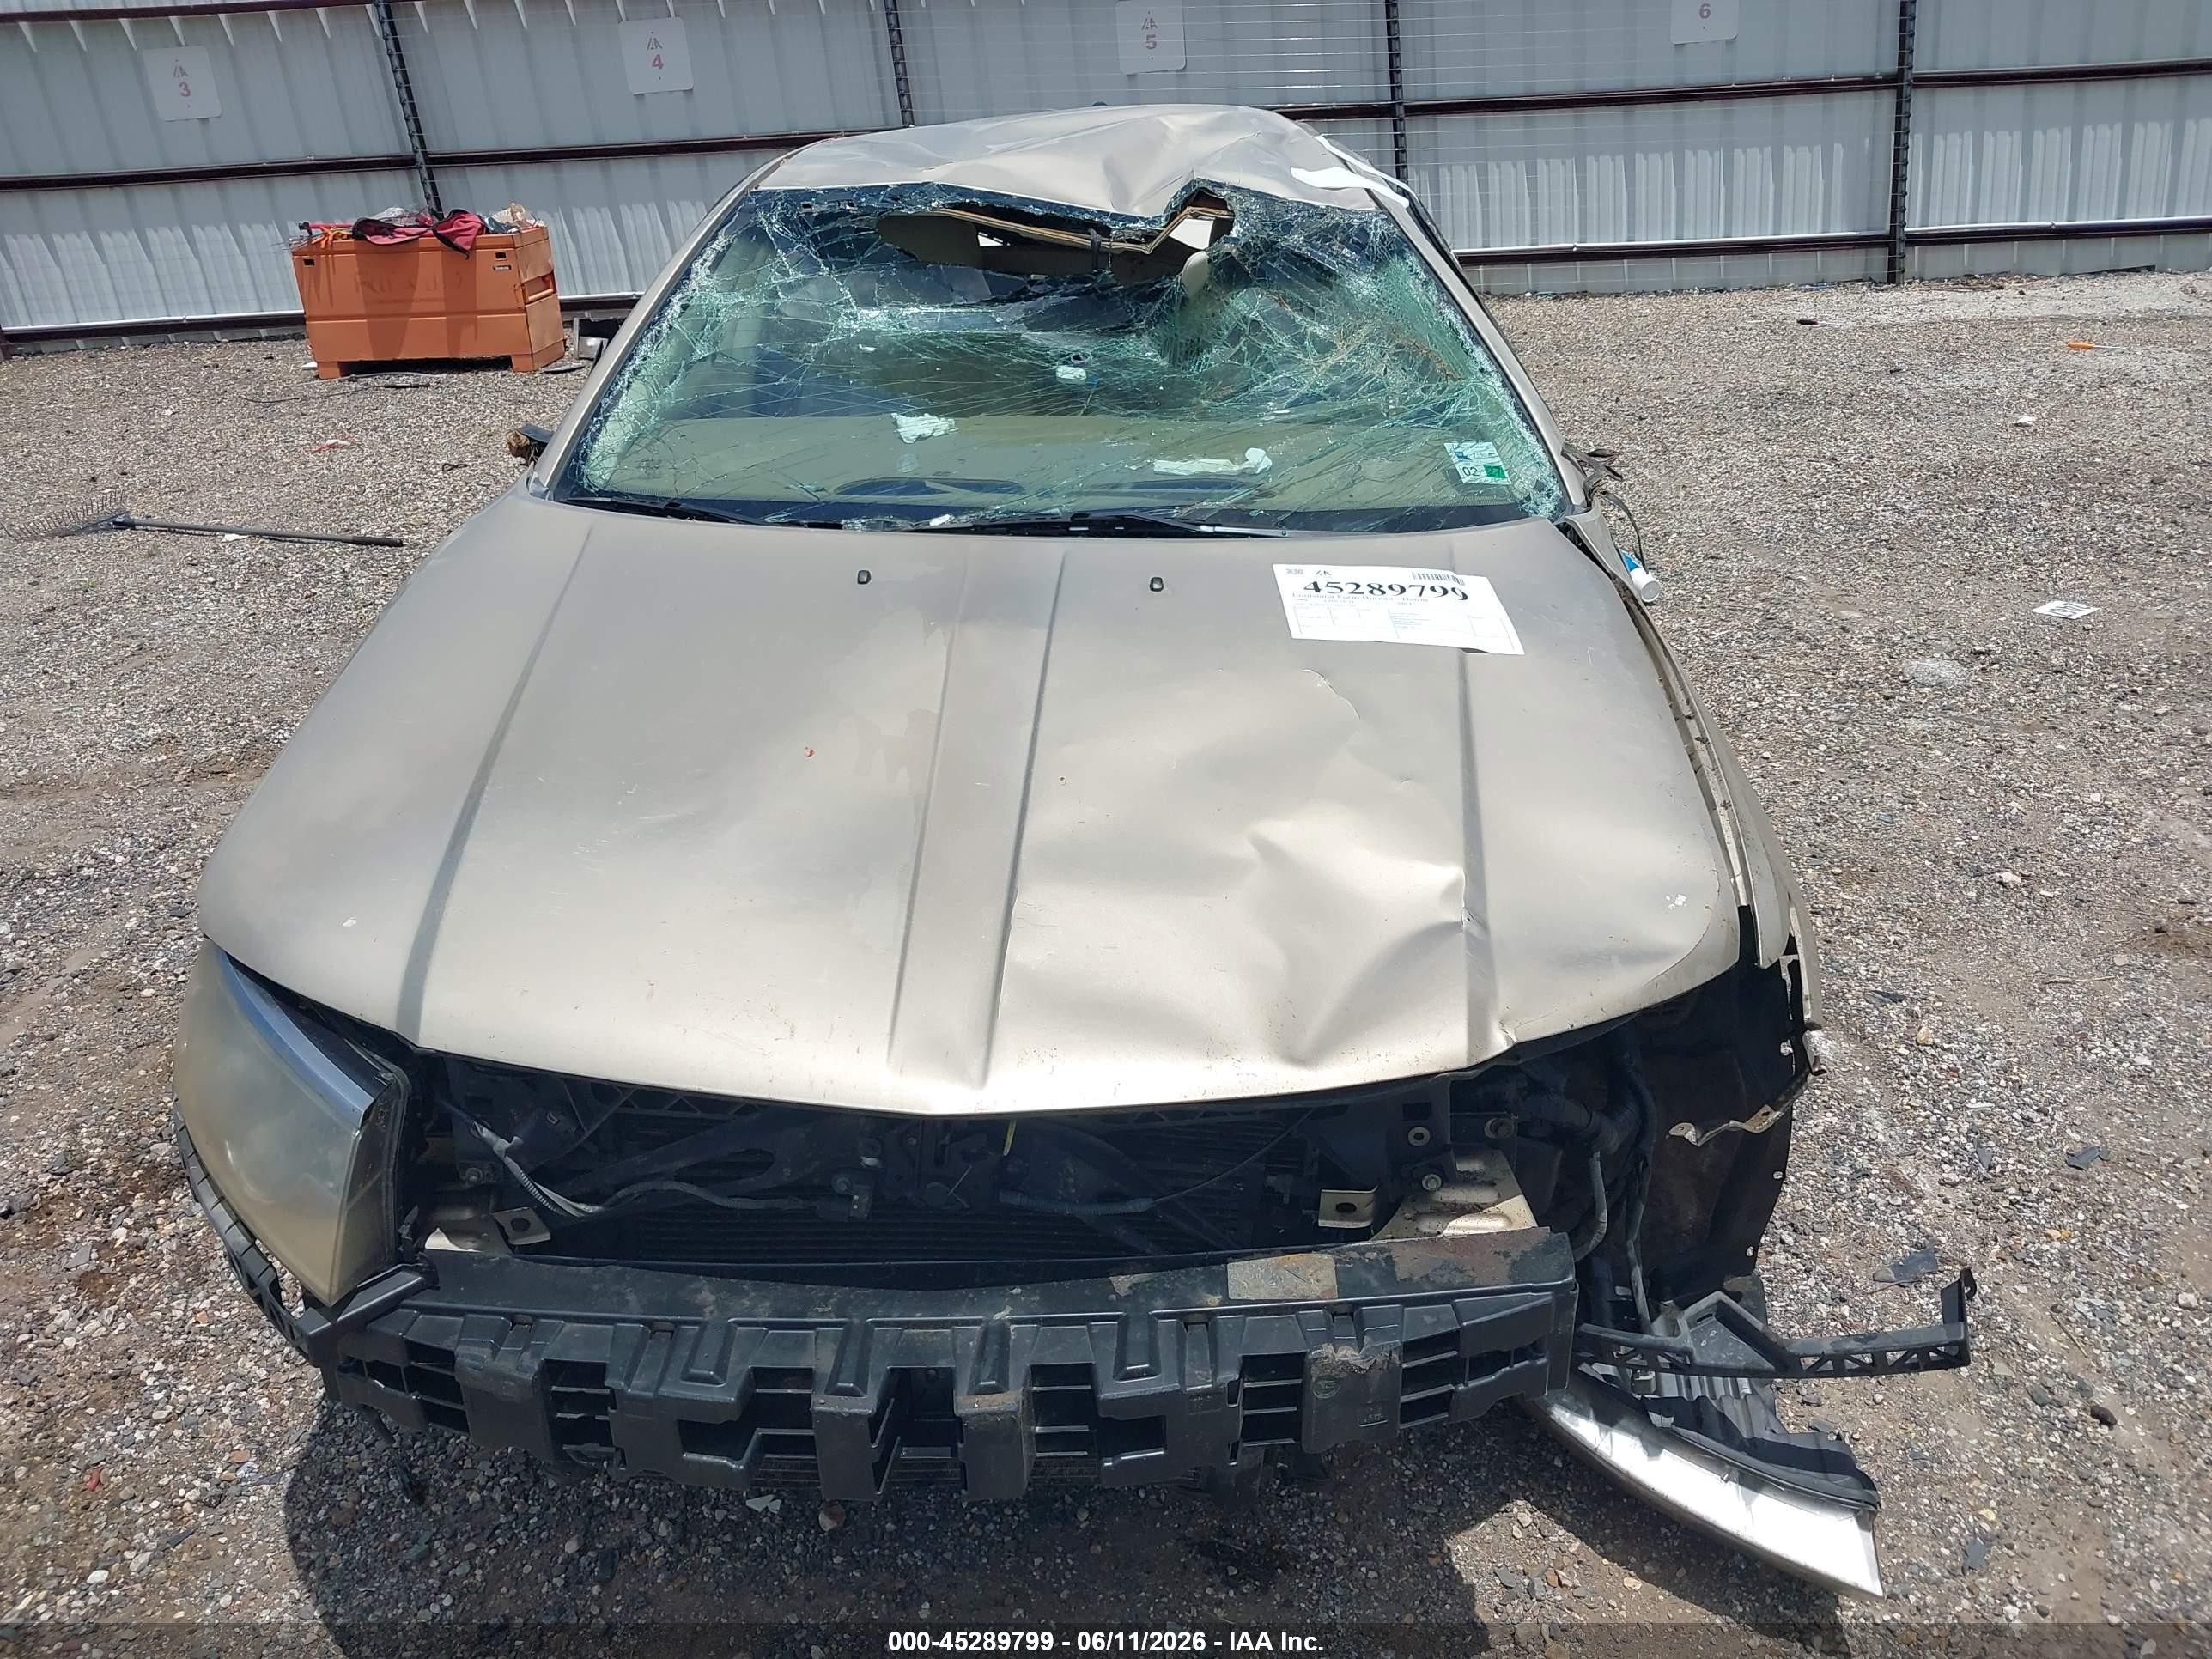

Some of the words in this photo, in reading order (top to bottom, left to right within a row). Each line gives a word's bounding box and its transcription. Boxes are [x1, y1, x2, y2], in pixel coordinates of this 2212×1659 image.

[1699, 3, 1711, 19] 6
[1146, 34, 1157, 50] 5
[652, 54, 665, 70] 4
[179, 82, 191, 97] 3
[1462, 466, 1480, 477] 02
[1304, 580, 1468, 601] 45289799
